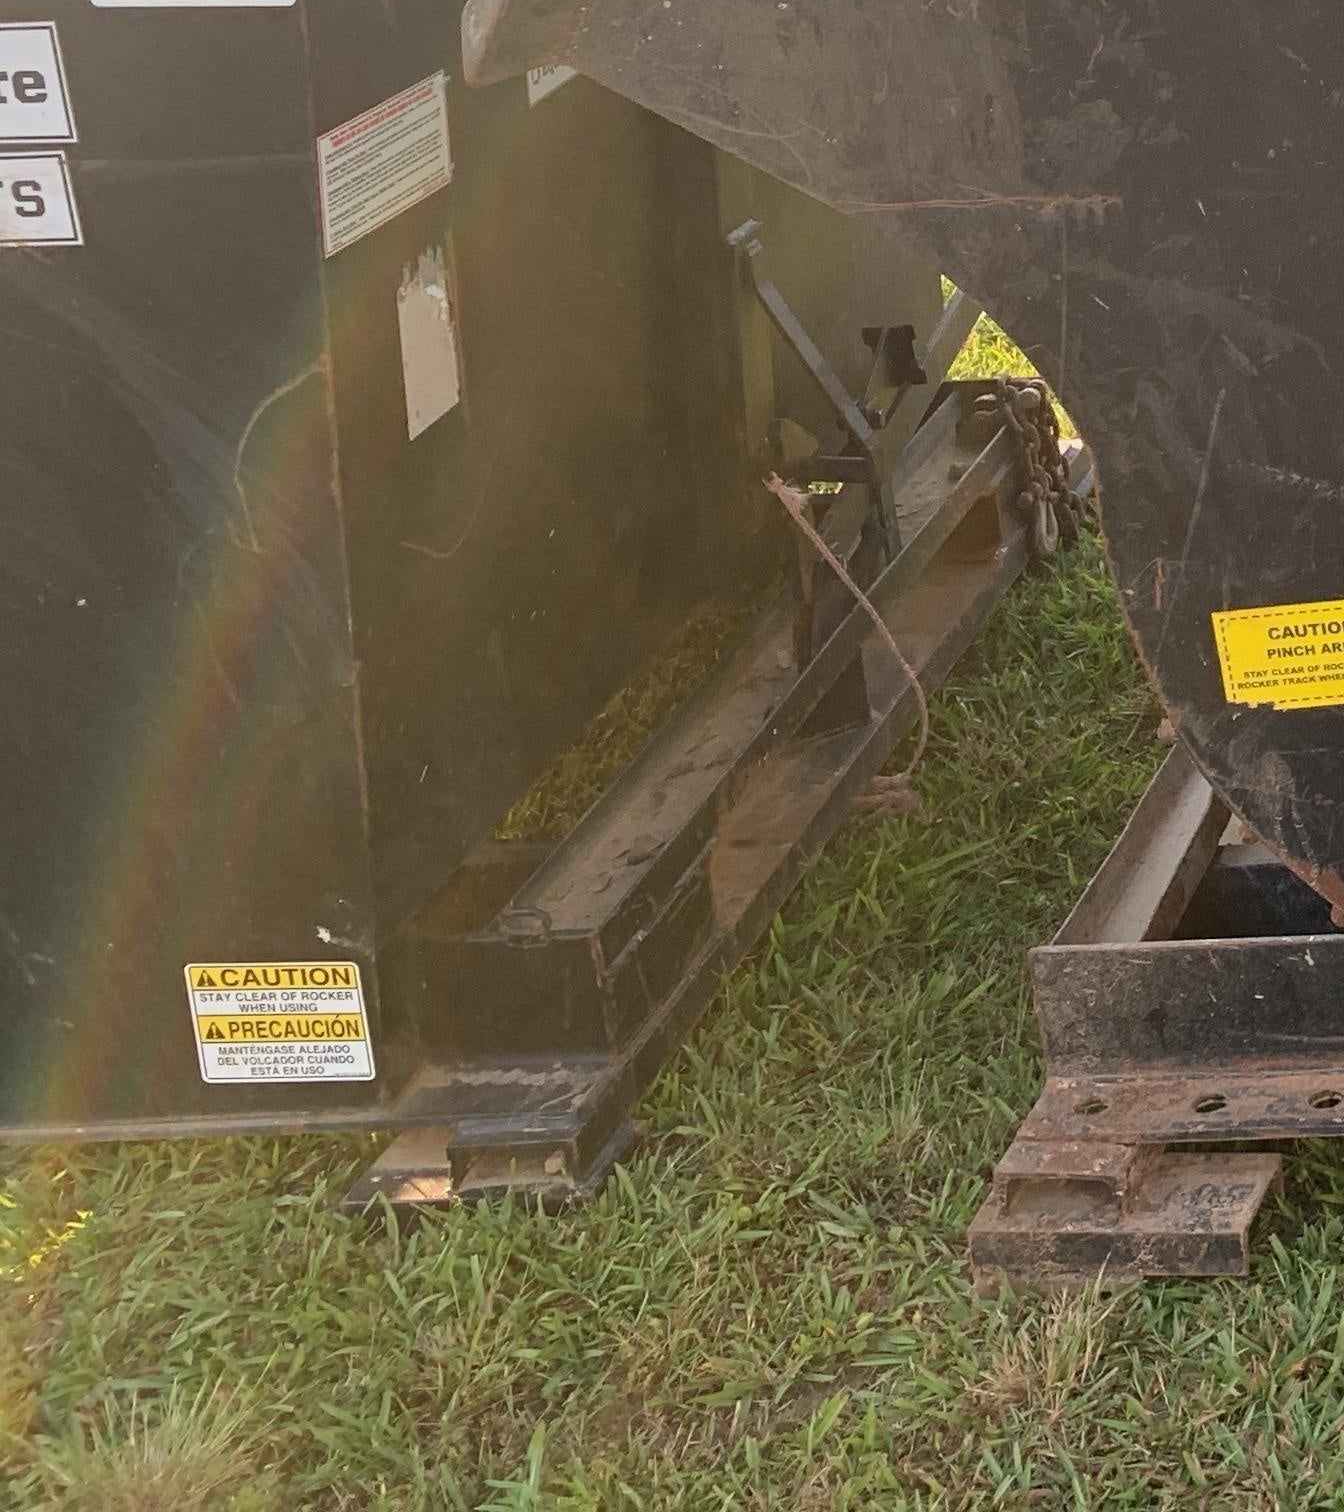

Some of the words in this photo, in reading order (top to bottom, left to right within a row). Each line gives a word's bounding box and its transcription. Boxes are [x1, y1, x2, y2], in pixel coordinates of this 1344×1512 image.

[0, 179, 46, 217] S
[1267, 645, 1316, 660] PINCH
[1243, 669, 1268, 679] STAY
[1271, 666, 1304, 676] CLEAR
[1307, 664, 1320, 673] OF
[1237, 679, 1279, 690] ROCKER
[1282, 675, 1317, 685] TRACK
[220, 967, 351, 986] CAUTION
[199, 992, 232, 1002] STAY
[235, 992, 277, 1002] CLEAR
[280, 991, 299, 1001] OF
[302, 991, 354, 1001] ROCKER
[238, 1003, 276, 1013] WHEN
[279, 1003, 318, 1012] USING
[228, 1015, 360, 1039] PRECAUCIÓN
[218, 1043, 296, 1055] MANTÉNGASE
[299, 1044, 351, 1055] ALEJADO
[217, 1057, 239, 1065] DEL
[242, 1056, 304, 1065] VOLCADOR
[307, 1055, 355, 1064] CUANDO
[251, 1064, 280, 1075] ESTÁ
[283, 1066, 298, 1075] EN
[301, 1065, 325, 1075] USO
